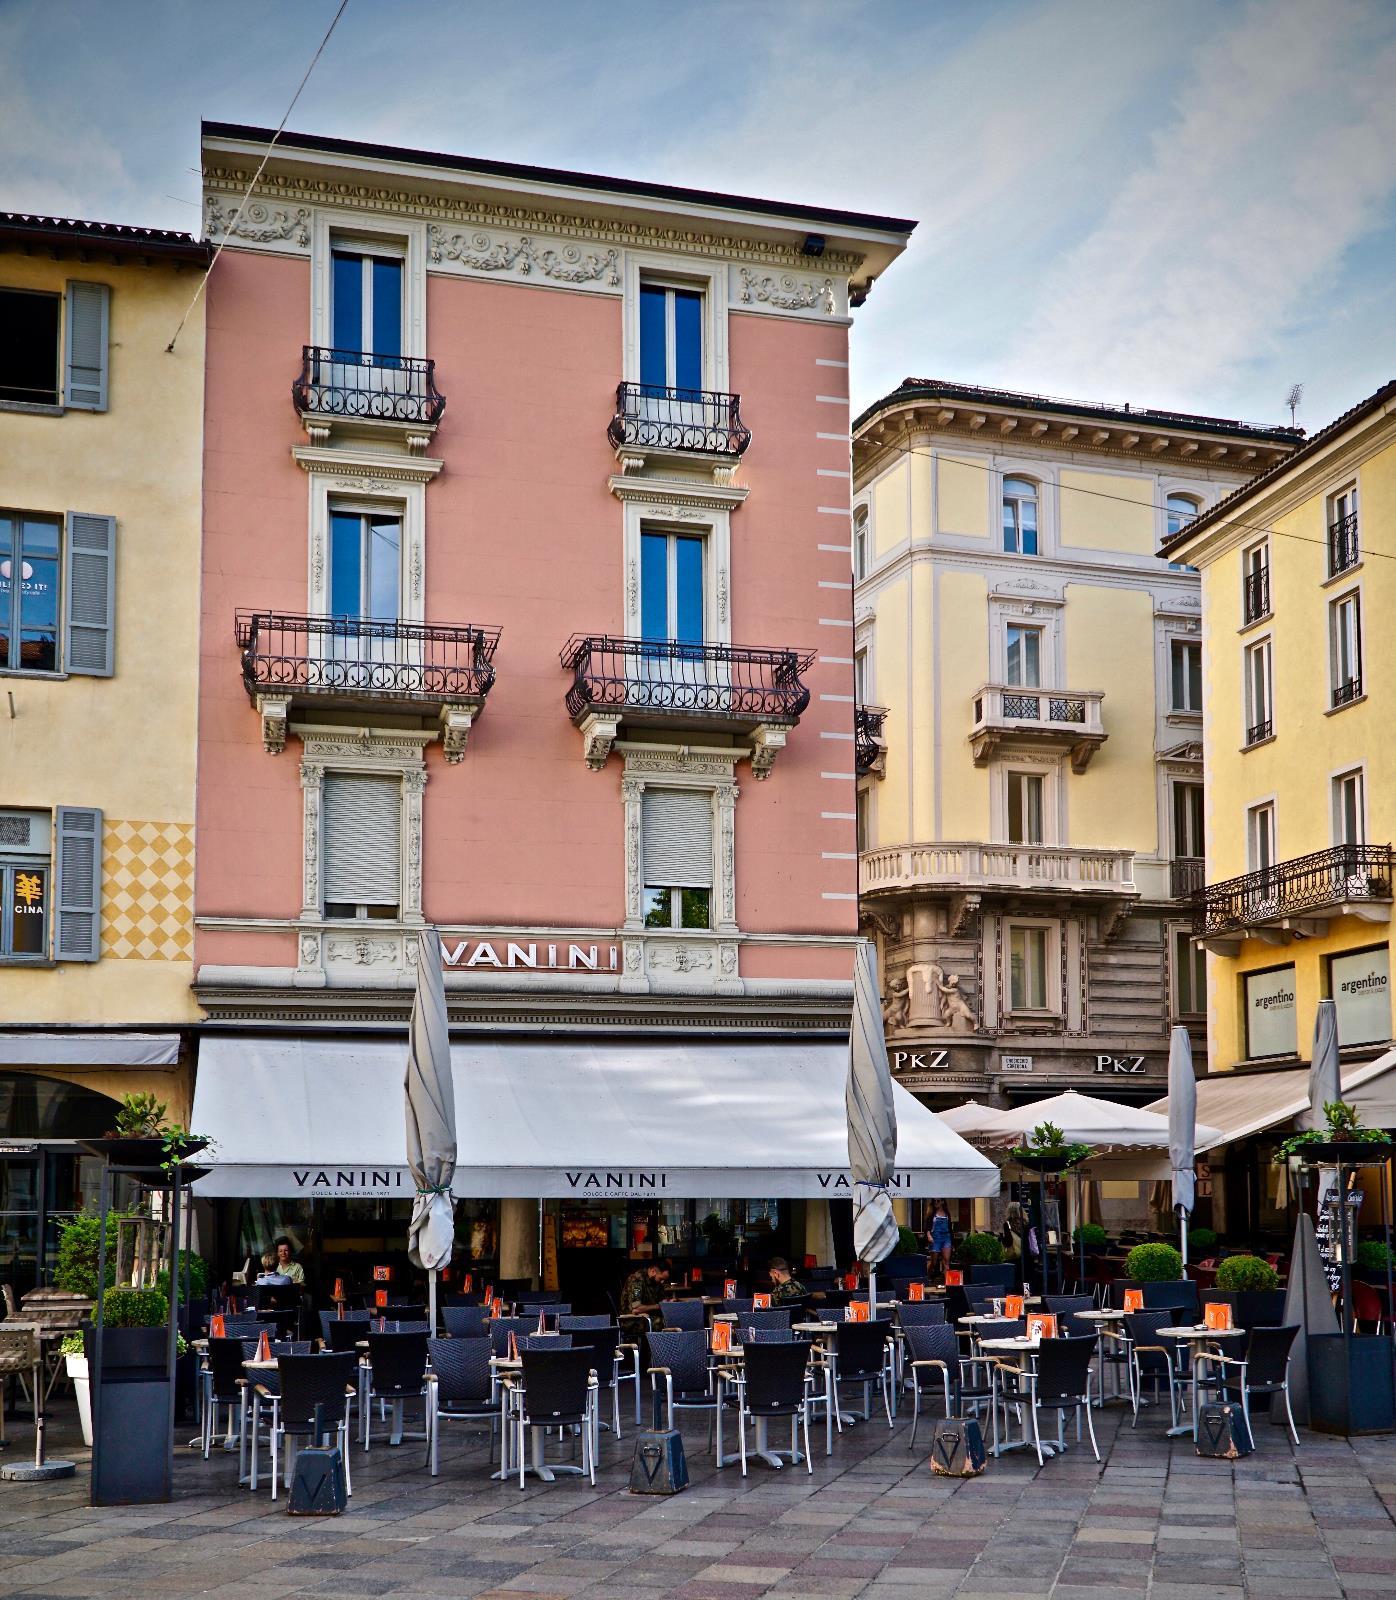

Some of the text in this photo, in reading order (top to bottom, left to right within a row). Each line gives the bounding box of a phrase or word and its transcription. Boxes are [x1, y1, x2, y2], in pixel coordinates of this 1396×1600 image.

[14, 905, 44, 914] CINA
[440, 940, 618, 970] VANINI
[1341, 970, 1388, 994] argentino
[1255, 988, 1295, 1010] argentino
[893, 1050, 950, 1070] PKZ
[1095, 1055, 1146, 1073] PKZ
[292, 1171, 402, 1187] VANINI
[565, 1172, 667, 1188] VANINI
[816, 1173, 911, 1188] VANI
